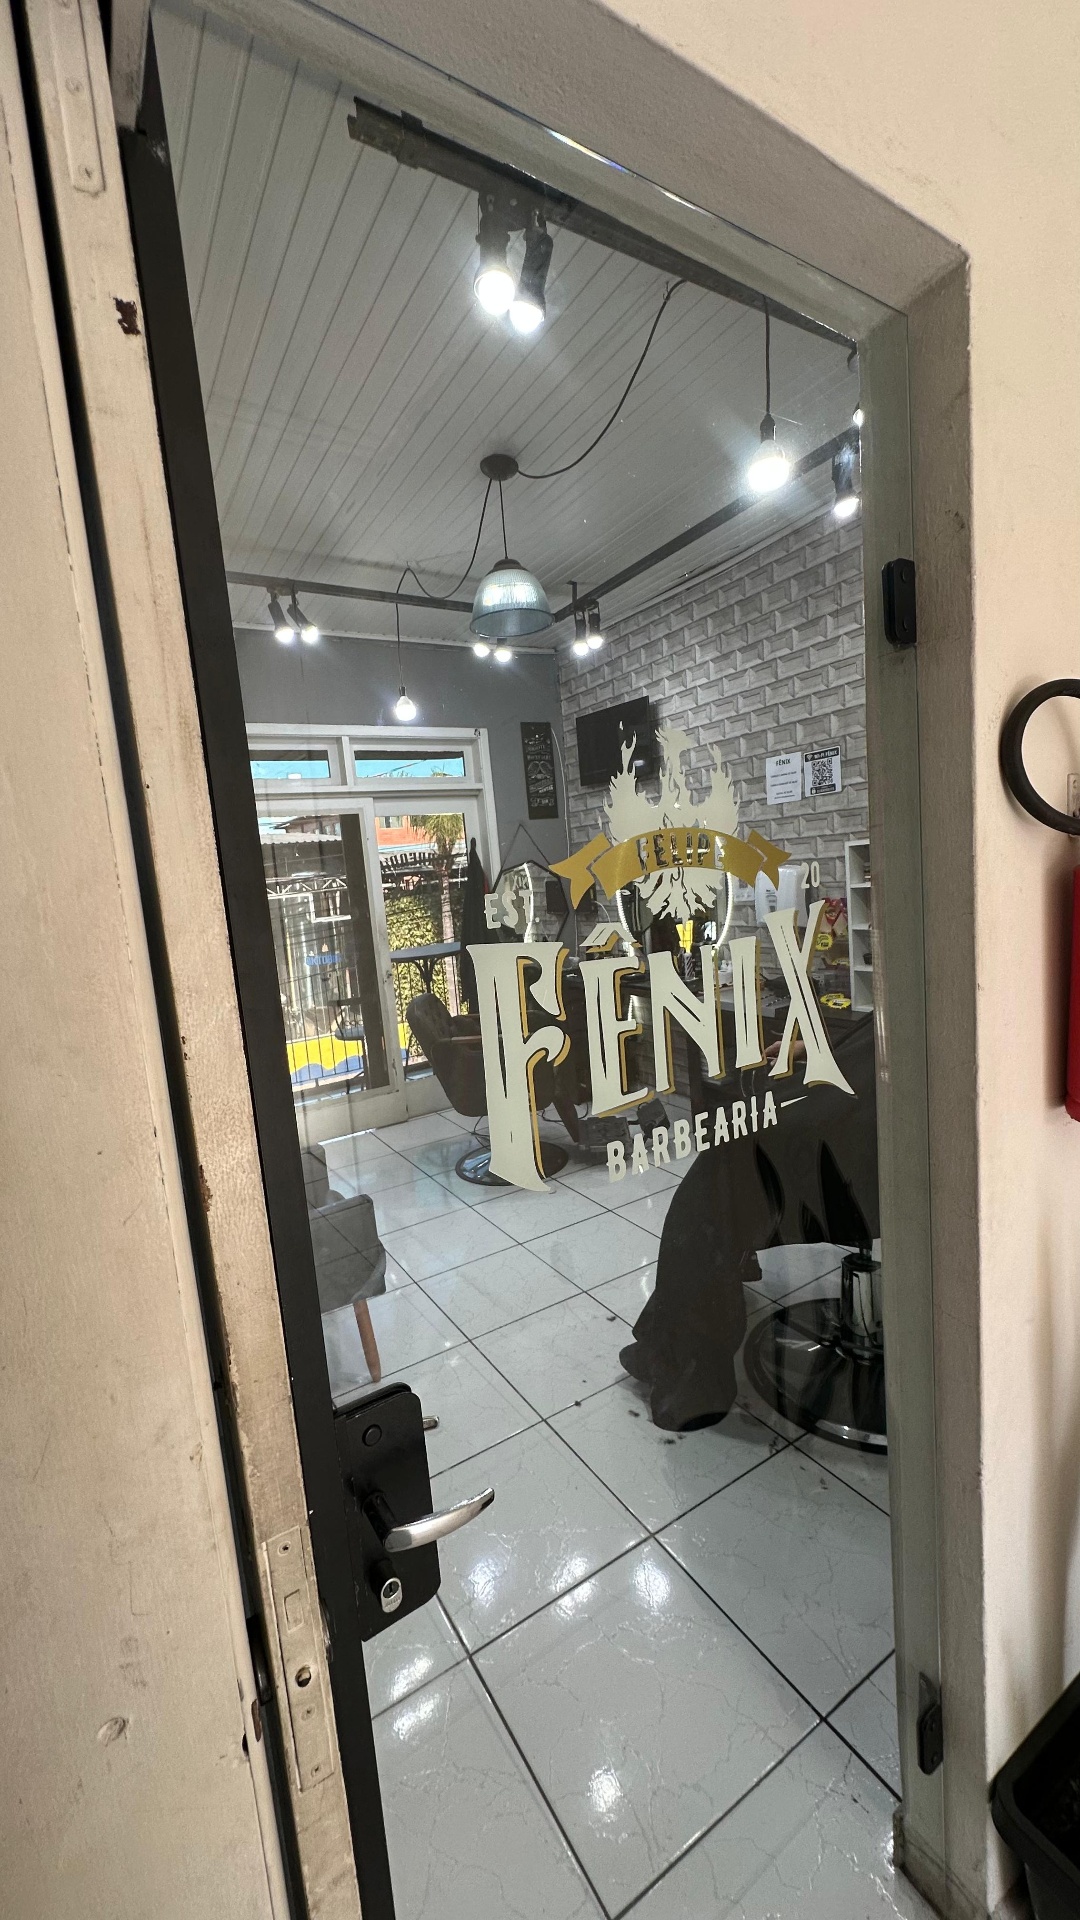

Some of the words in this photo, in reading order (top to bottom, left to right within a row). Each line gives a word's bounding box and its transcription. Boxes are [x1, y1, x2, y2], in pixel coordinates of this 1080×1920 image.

[776, 758, 791, 766] FÊNIX
[636, 832, 727, 872] FELIPE
[800, 861, 820, 889] 20
[466, 899, 857, 1193] FÊNIX
[606, 1090, 778, 1184] BARBEARIA
